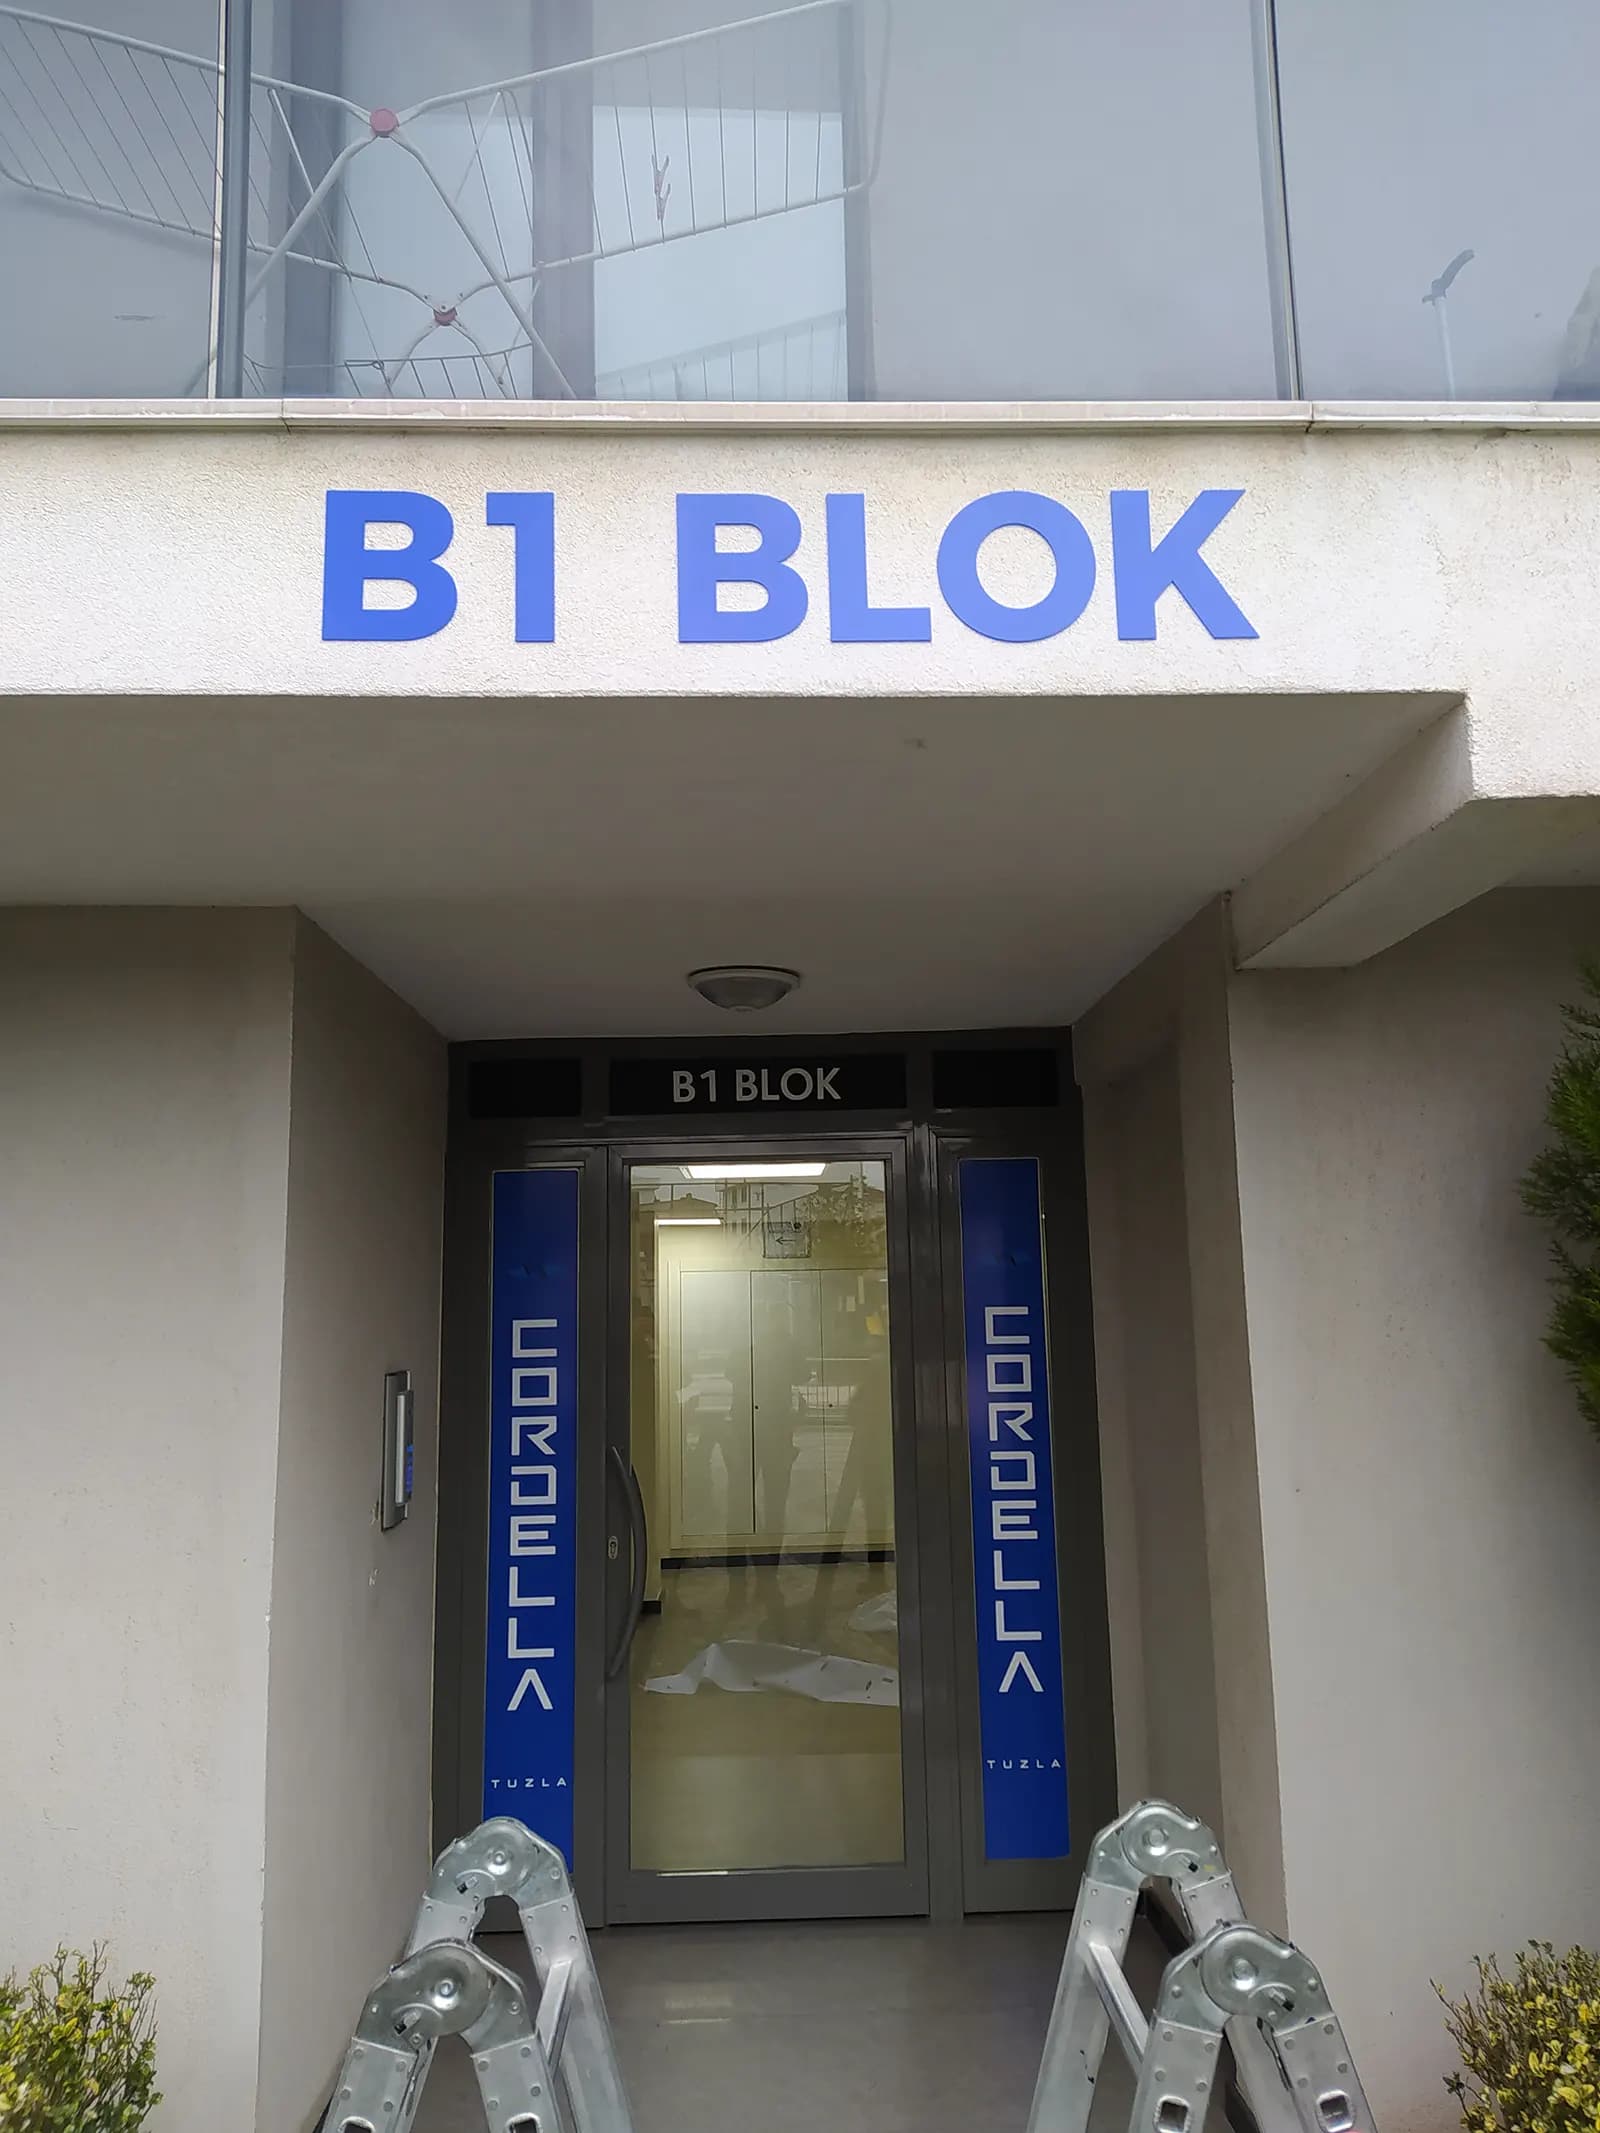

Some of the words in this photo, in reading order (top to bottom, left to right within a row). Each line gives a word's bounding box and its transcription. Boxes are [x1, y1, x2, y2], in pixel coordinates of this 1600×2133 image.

[321, 490, 555, 642] B1
[676, 489, 1259, 642] BLOK
[672, 1070, 717, 1103] B1
[735, 1067, 842, 1102] BLOK
[507, 1319, 557, 1711] CORDELLA
[984, 1306, 1044, 1693] CORDELLA
[491, 1777, 567, 1788] TUZLA
[987, 1759, 1061, 1769] TUZLA
